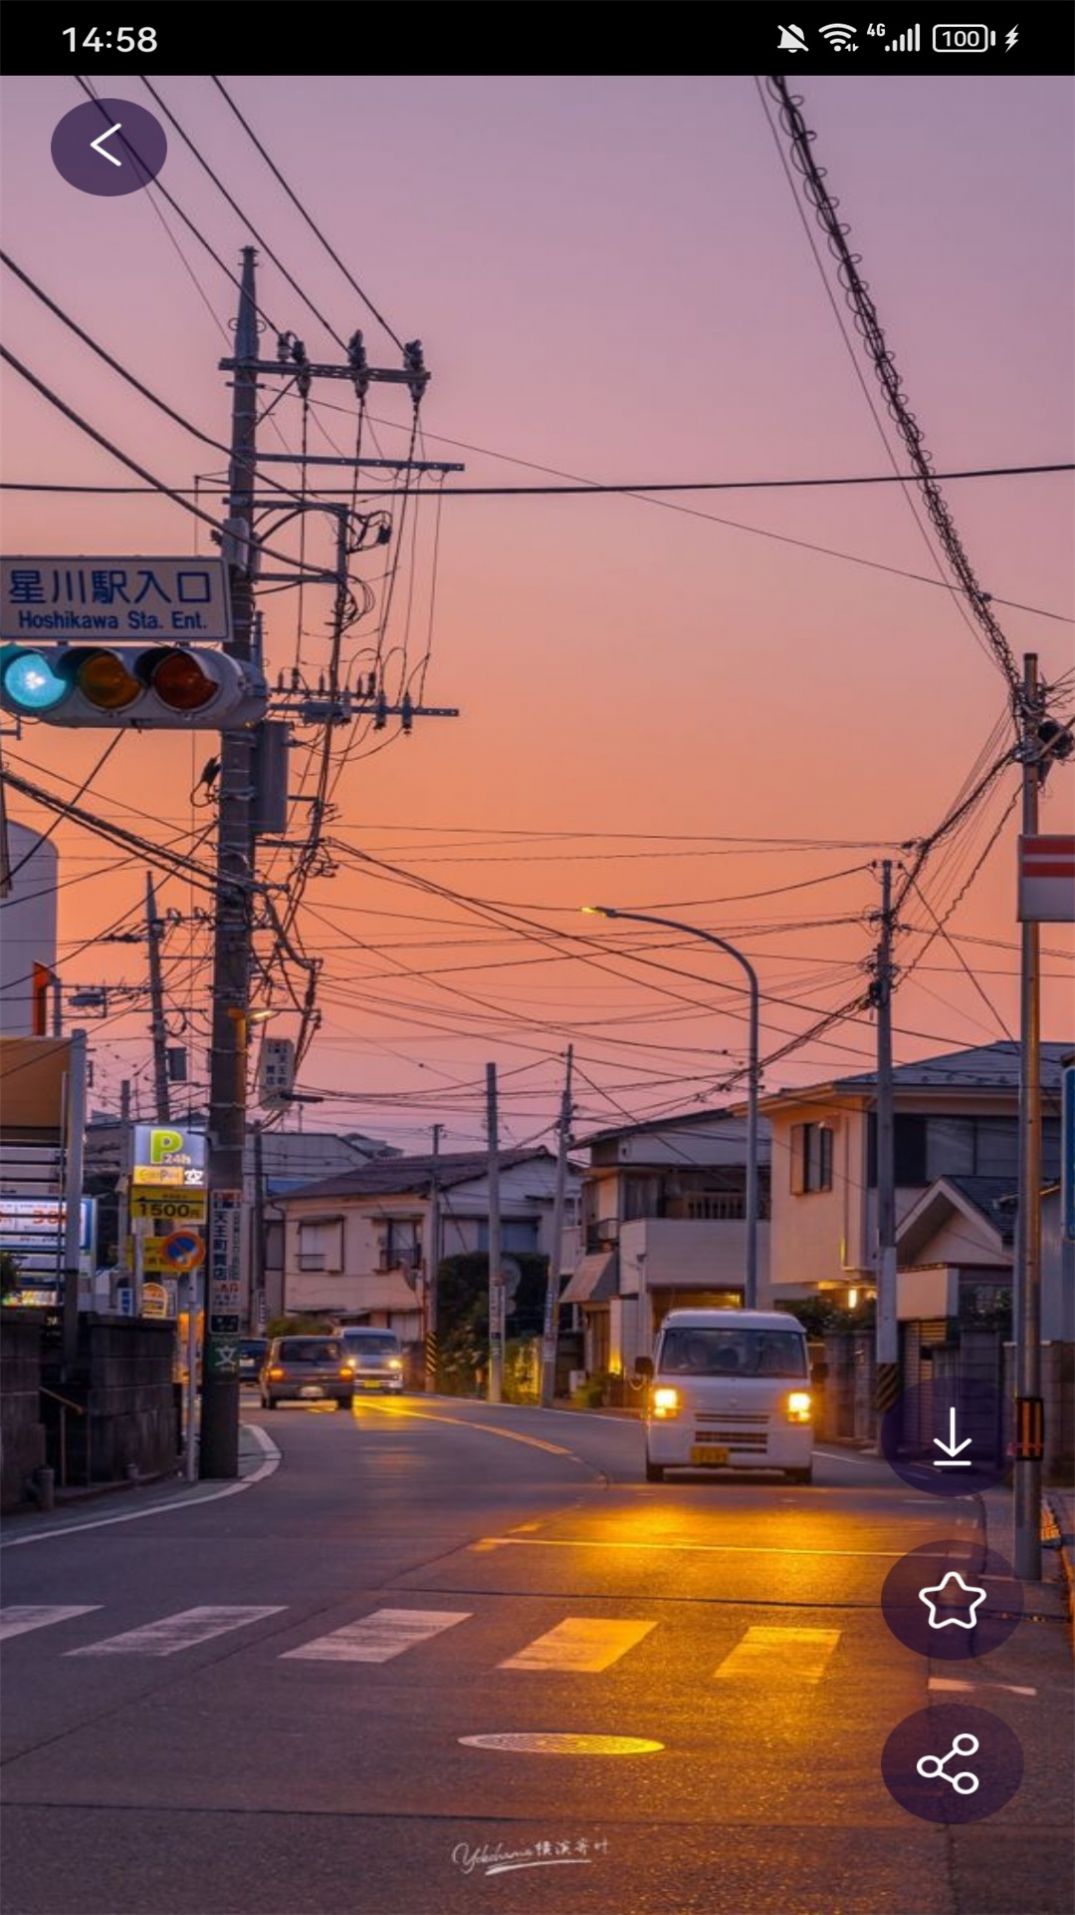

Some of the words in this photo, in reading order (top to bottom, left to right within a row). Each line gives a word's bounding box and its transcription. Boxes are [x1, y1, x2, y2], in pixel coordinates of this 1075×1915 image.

[9, 569, 212, 604] 星川駅入口
[18, 610, 118, 629] Hoshikawa
[128, 611, 163, 629] Sta.
[171, 611, 207, 629] Ent.
[150, 1128, 183, 1164] P
